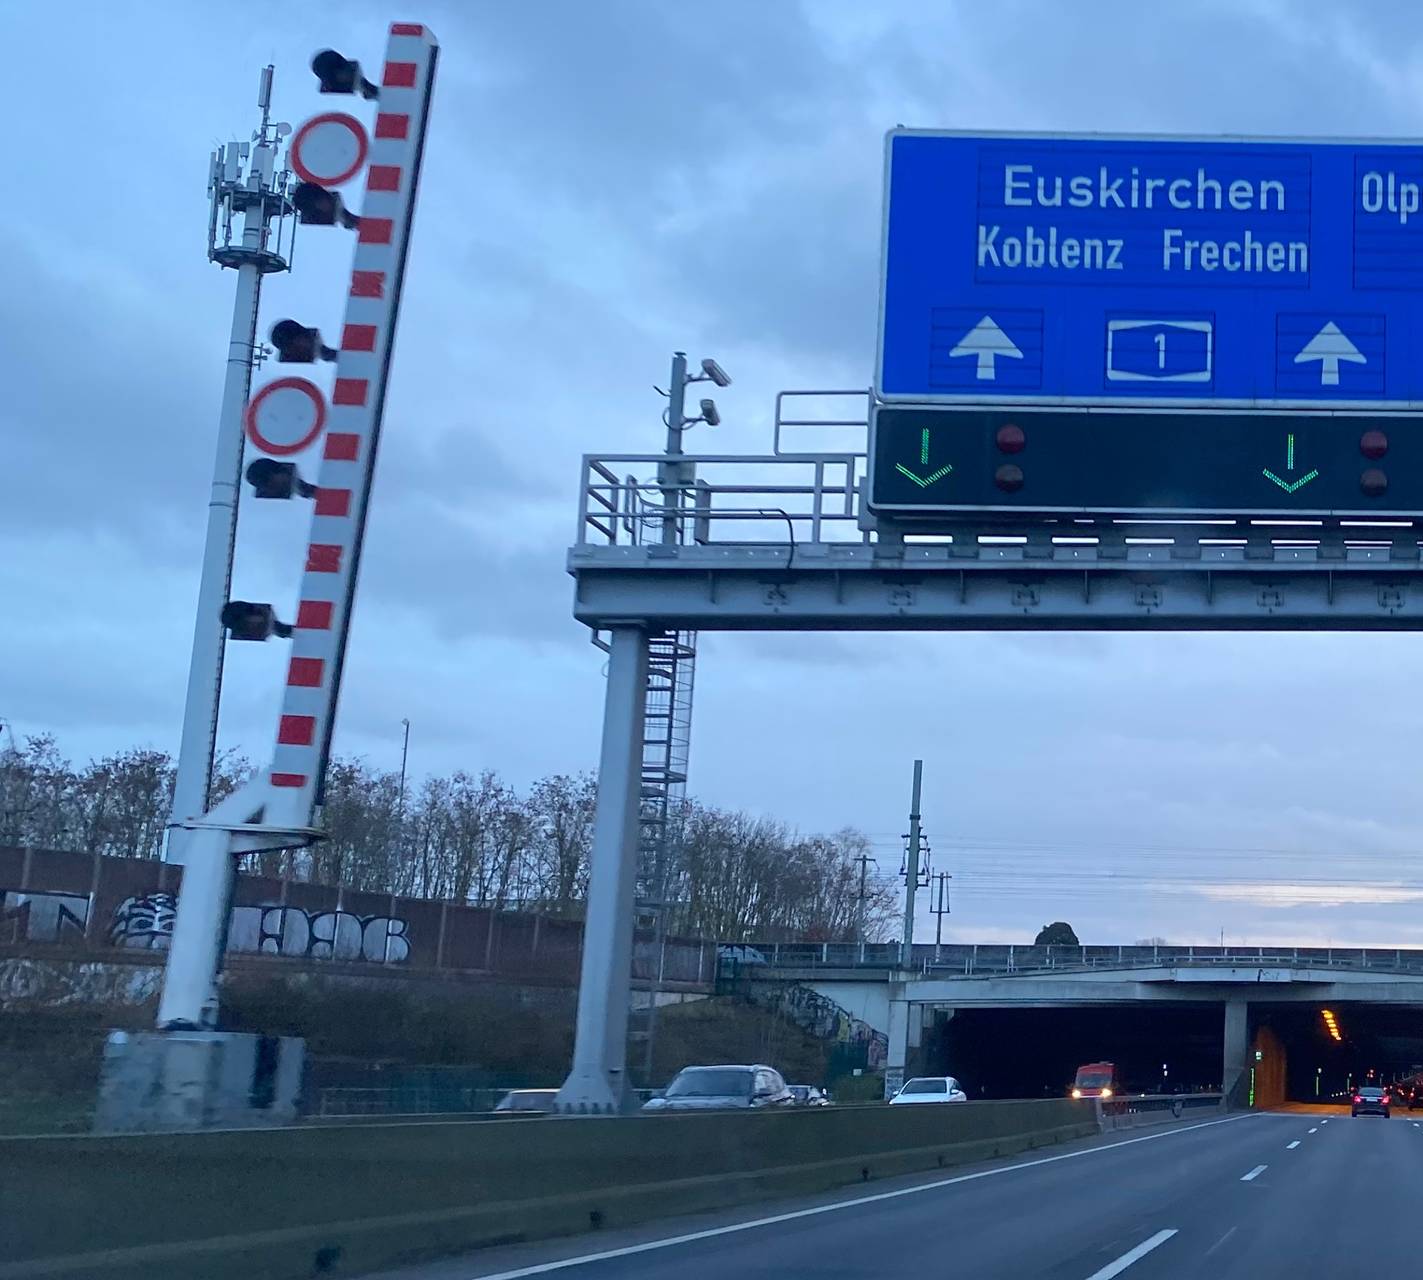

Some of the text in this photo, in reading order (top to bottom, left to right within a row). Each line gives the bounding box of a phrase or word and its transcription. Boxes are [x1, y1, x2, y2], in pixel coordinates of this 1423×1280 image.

[1004, 164, 1286, 211] Euskirchen
[977, 225, 1308, 272] Koblenz Frechen
[1154, 333, 1166, 369] 1
